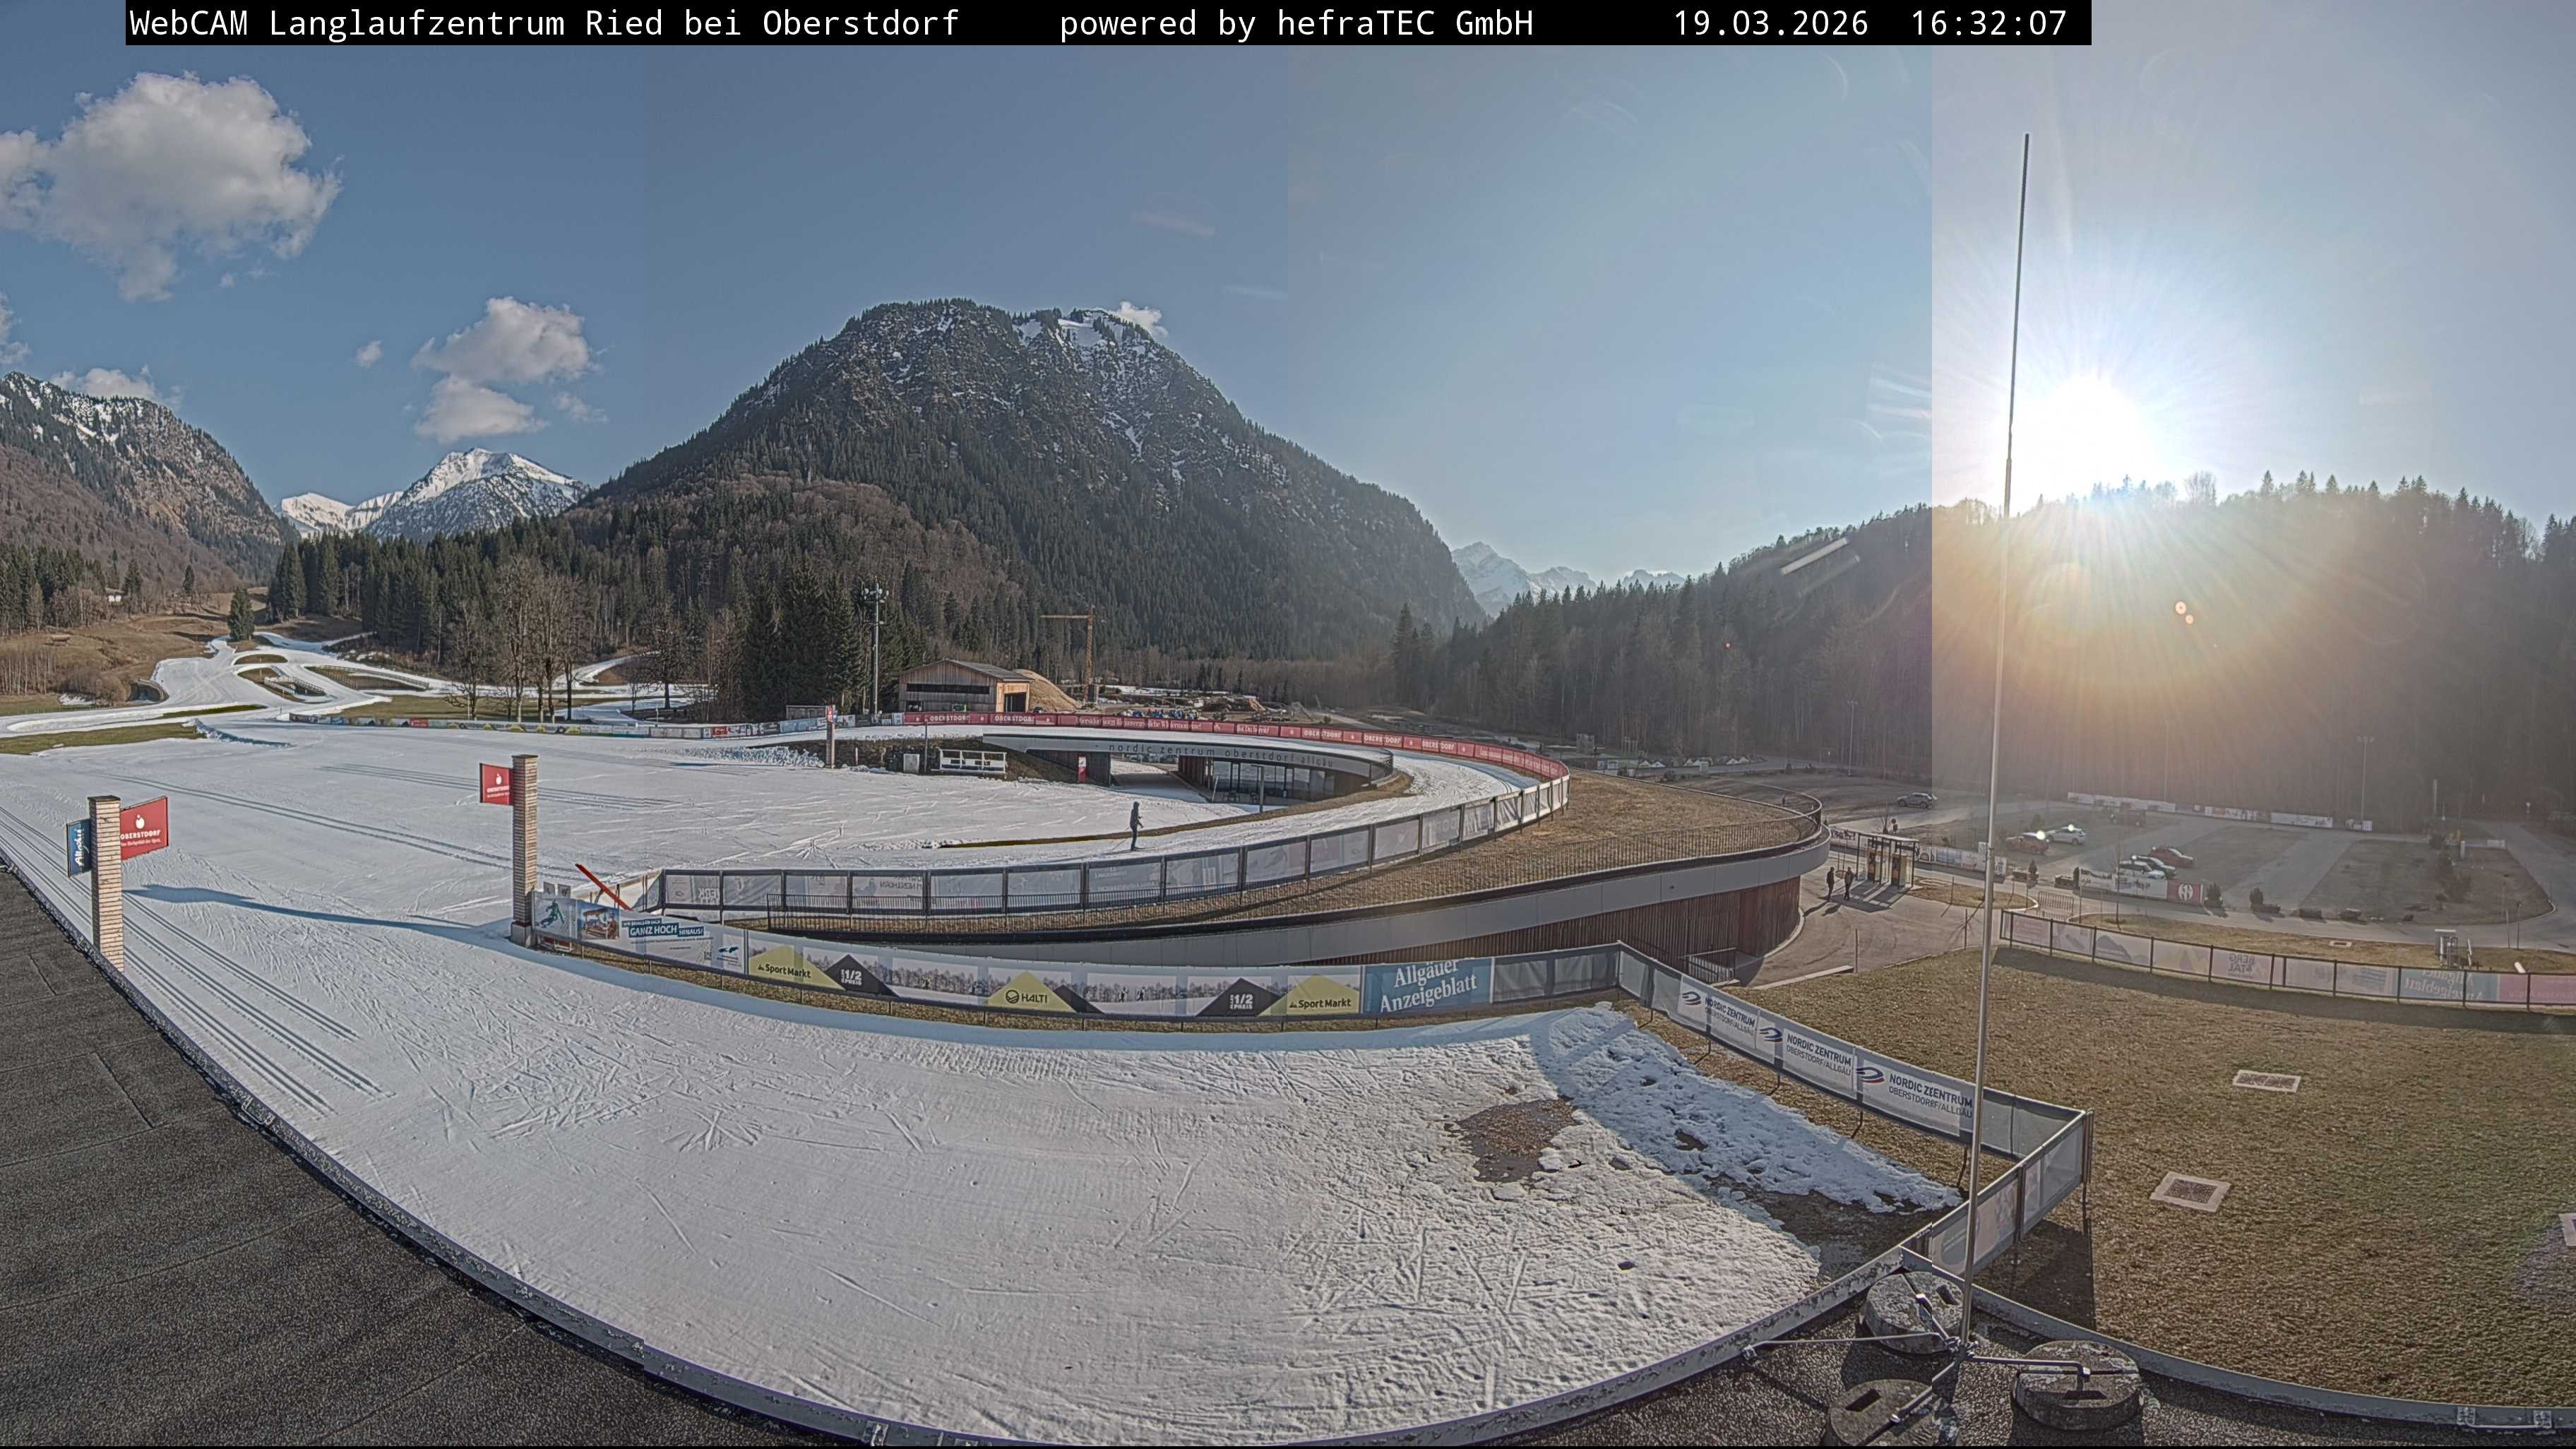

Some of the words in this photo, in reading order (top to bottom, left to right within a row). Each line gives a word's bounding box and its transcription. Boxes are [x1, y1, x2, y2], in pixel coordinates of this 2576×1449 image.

[1304, 729, 1342, 739] OBERTDORF
[1109, 743, 1152, 753] nordic
[1159, 746, 1215, 756] zentrum
[1225, 749, 1294, 763] oberstdorf
[120, 830, 162, 840] OBERSTDORF
[654, 924, 677, 935] HOCH
[765, 963, 787, 975] Sport
[787, 968, 811, 979] Markt
[845, 970, 861, 979] 1/2
[1394, 960, 1460, 987] Allgäuer
[1021, 993, 1048, 1003] HALTI
[1234, 994, 1253, 1004] 1/2
[1381, 974, 1478, 1013] Anzeigeblatt
[1298, 999, 1323, 1010] Sport
[1325, 998, 1351, 1008] Markt
[1705, 997, 1727, 1013] NORDIC
[1727, 1006, 1755, 1027] ZENTRUM
[1787, 1033, 1814, 1051] NORDIC
[1815, 1045, 1852, 1066] ZENTRUM
[1890, 1073, 1922, 1093] NORDIC
